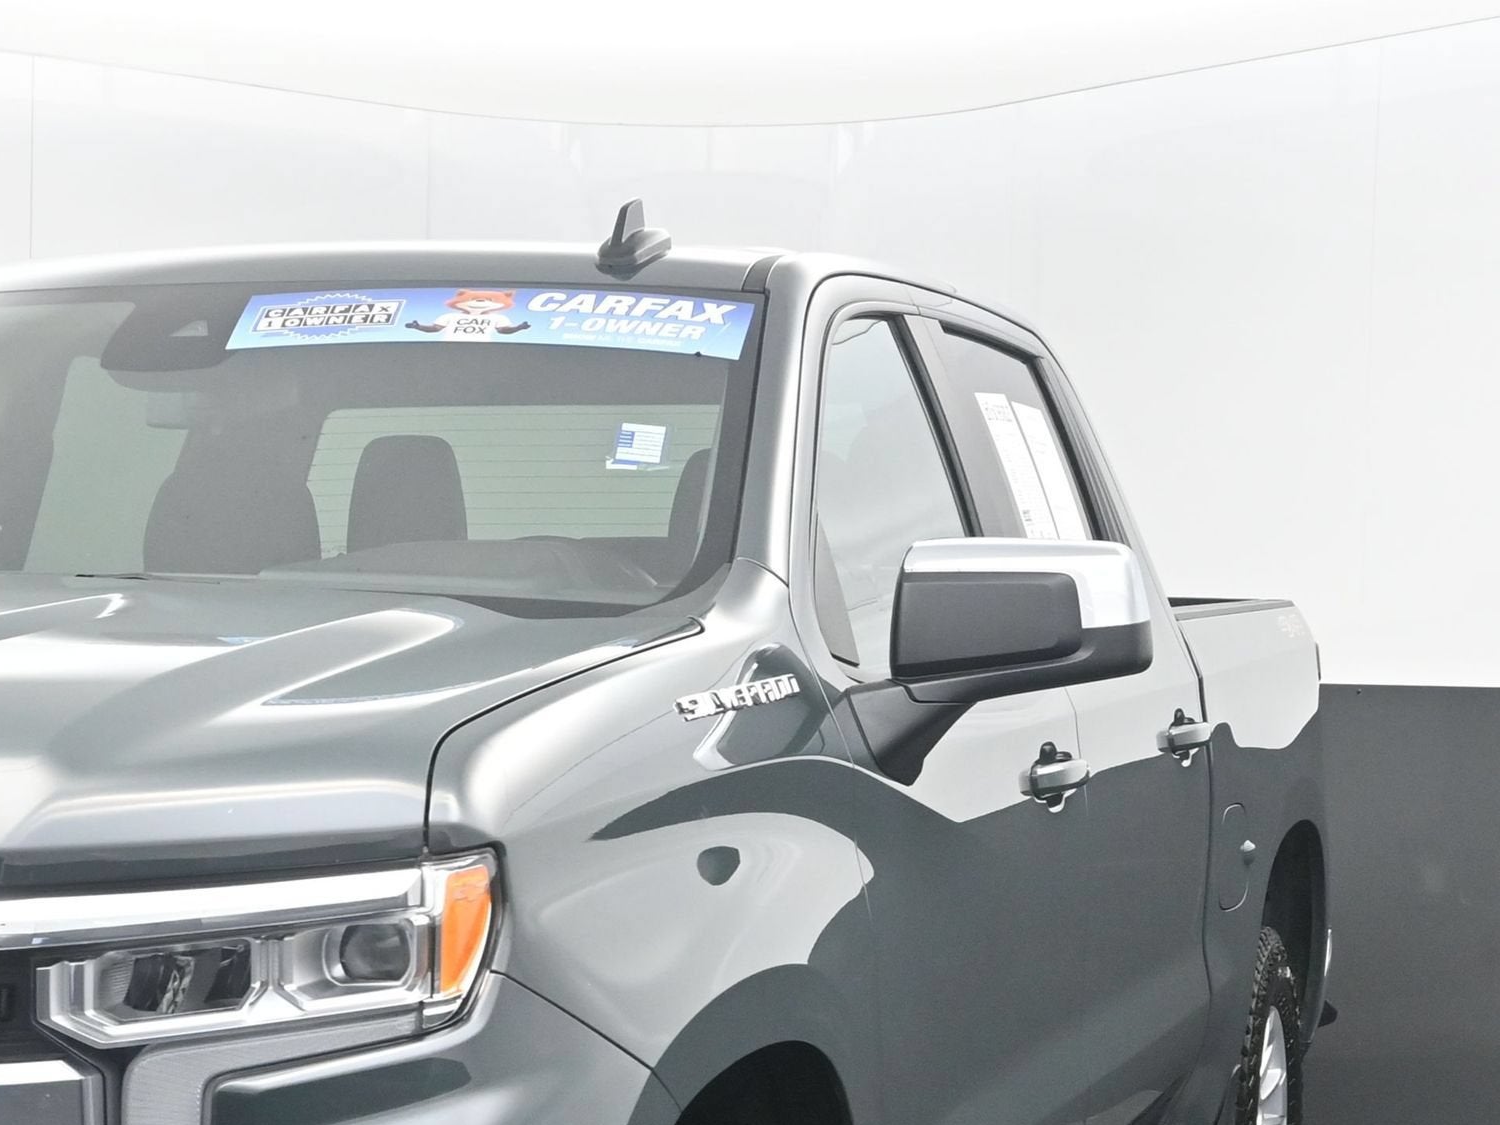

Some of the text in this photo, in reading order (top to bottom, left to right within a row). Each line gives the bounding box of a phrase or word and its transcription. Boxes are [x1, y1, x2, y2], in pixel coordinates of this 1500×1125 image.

[266, 303, 393, 318] CARFAX
[527, 291, 738, 325] CARFAX
[282, 313, 389, 328] OWNER
[456, 318, 491, 326] CAR
[547, 315, 708, 341] 1-OWNER
[453, 326, 486, 334] FOX
